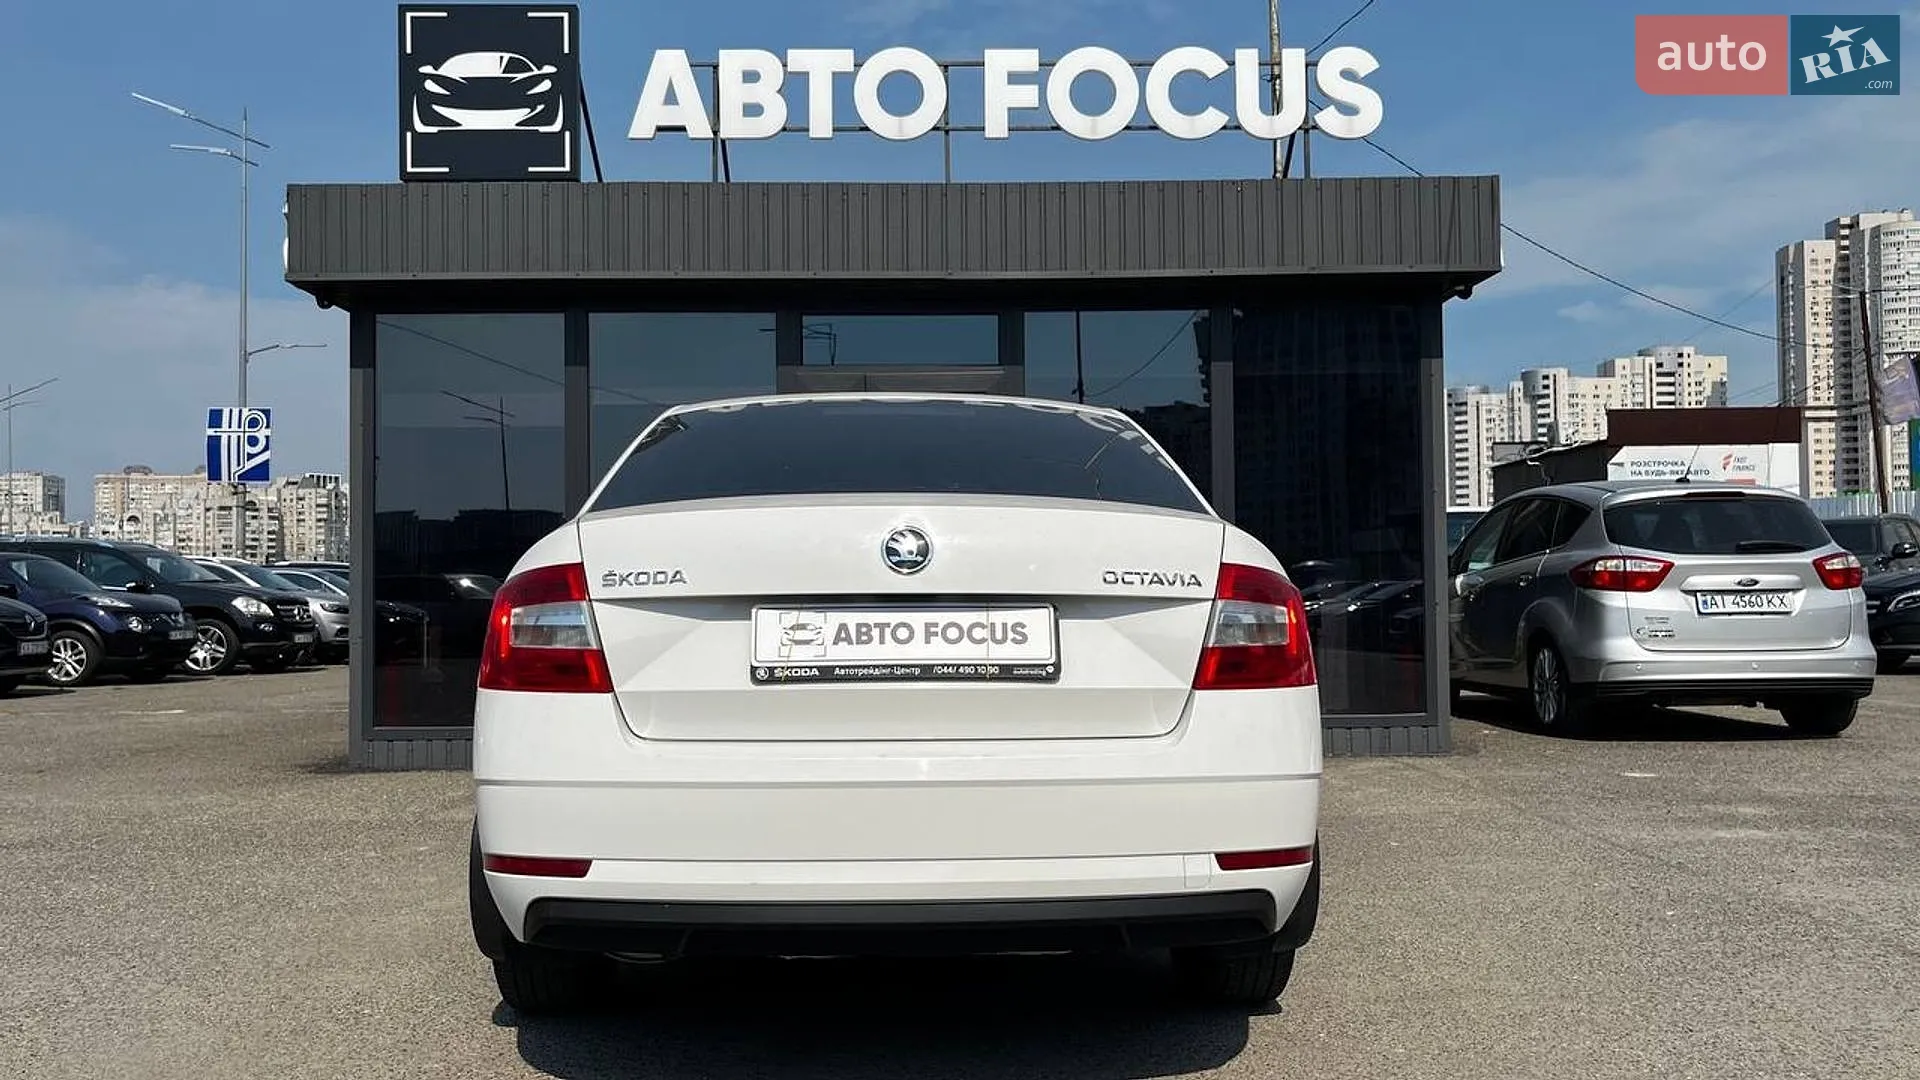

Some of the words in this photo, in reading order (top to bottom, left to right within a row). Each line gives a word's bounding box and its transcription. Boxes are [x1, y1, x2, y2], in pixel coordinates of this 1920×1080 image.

[629, 46, 947, 140] АВТО
[983, 45, 1384, 140] FOCUS
[602, 570, 688, 588] ŠKODA
[1102, 570, 1203, 588] OCTAVIA
[1710, 595, 1726, 609] AI
[1732, 595, 1764, 609] 4560
[1766, 594, 1788, 609] KX
[832, 622, 916, 646] АВТО
[923, 621, 1029, 645] FOCUS
